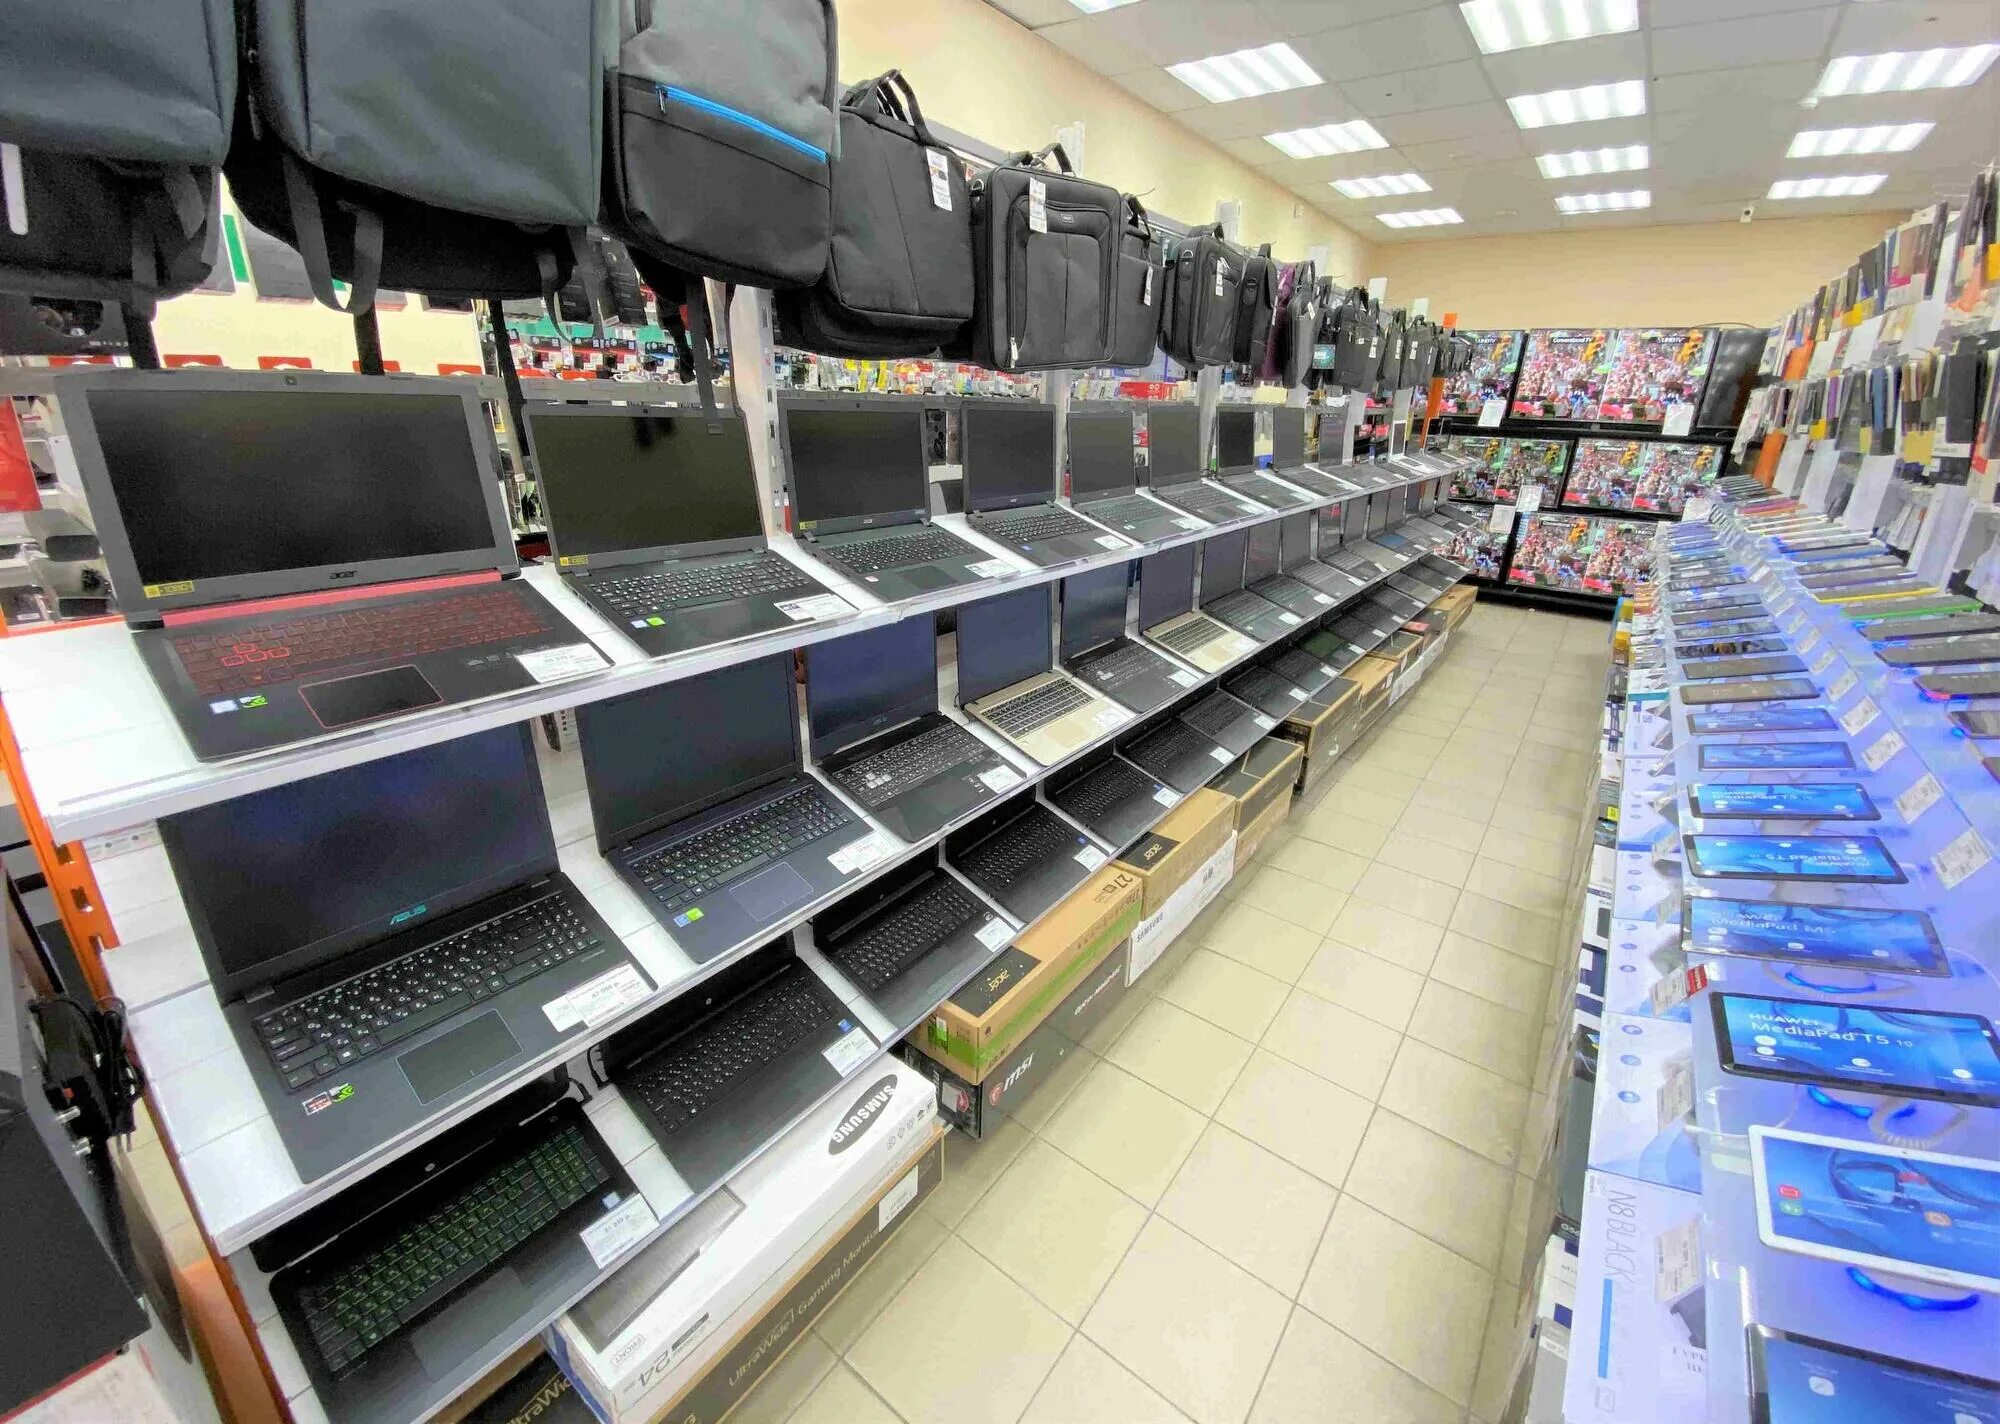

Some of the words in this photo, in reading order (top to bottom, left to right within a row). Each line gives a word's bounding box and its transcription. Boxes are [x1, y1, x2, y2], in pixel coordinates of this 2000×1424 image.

[329, 570, 358, 580] acer
[390, 903, 427, 925] ASUS
[1752, 1021, 1854, 1043] MediaPad
[1860, 1032, 1890, 1046] T5
[832, 1085, 896, 1145] SAMSUNG
[728, 1316, 793, 1387] UltraWide
[797, 1267, 842, 1315] Gaming
